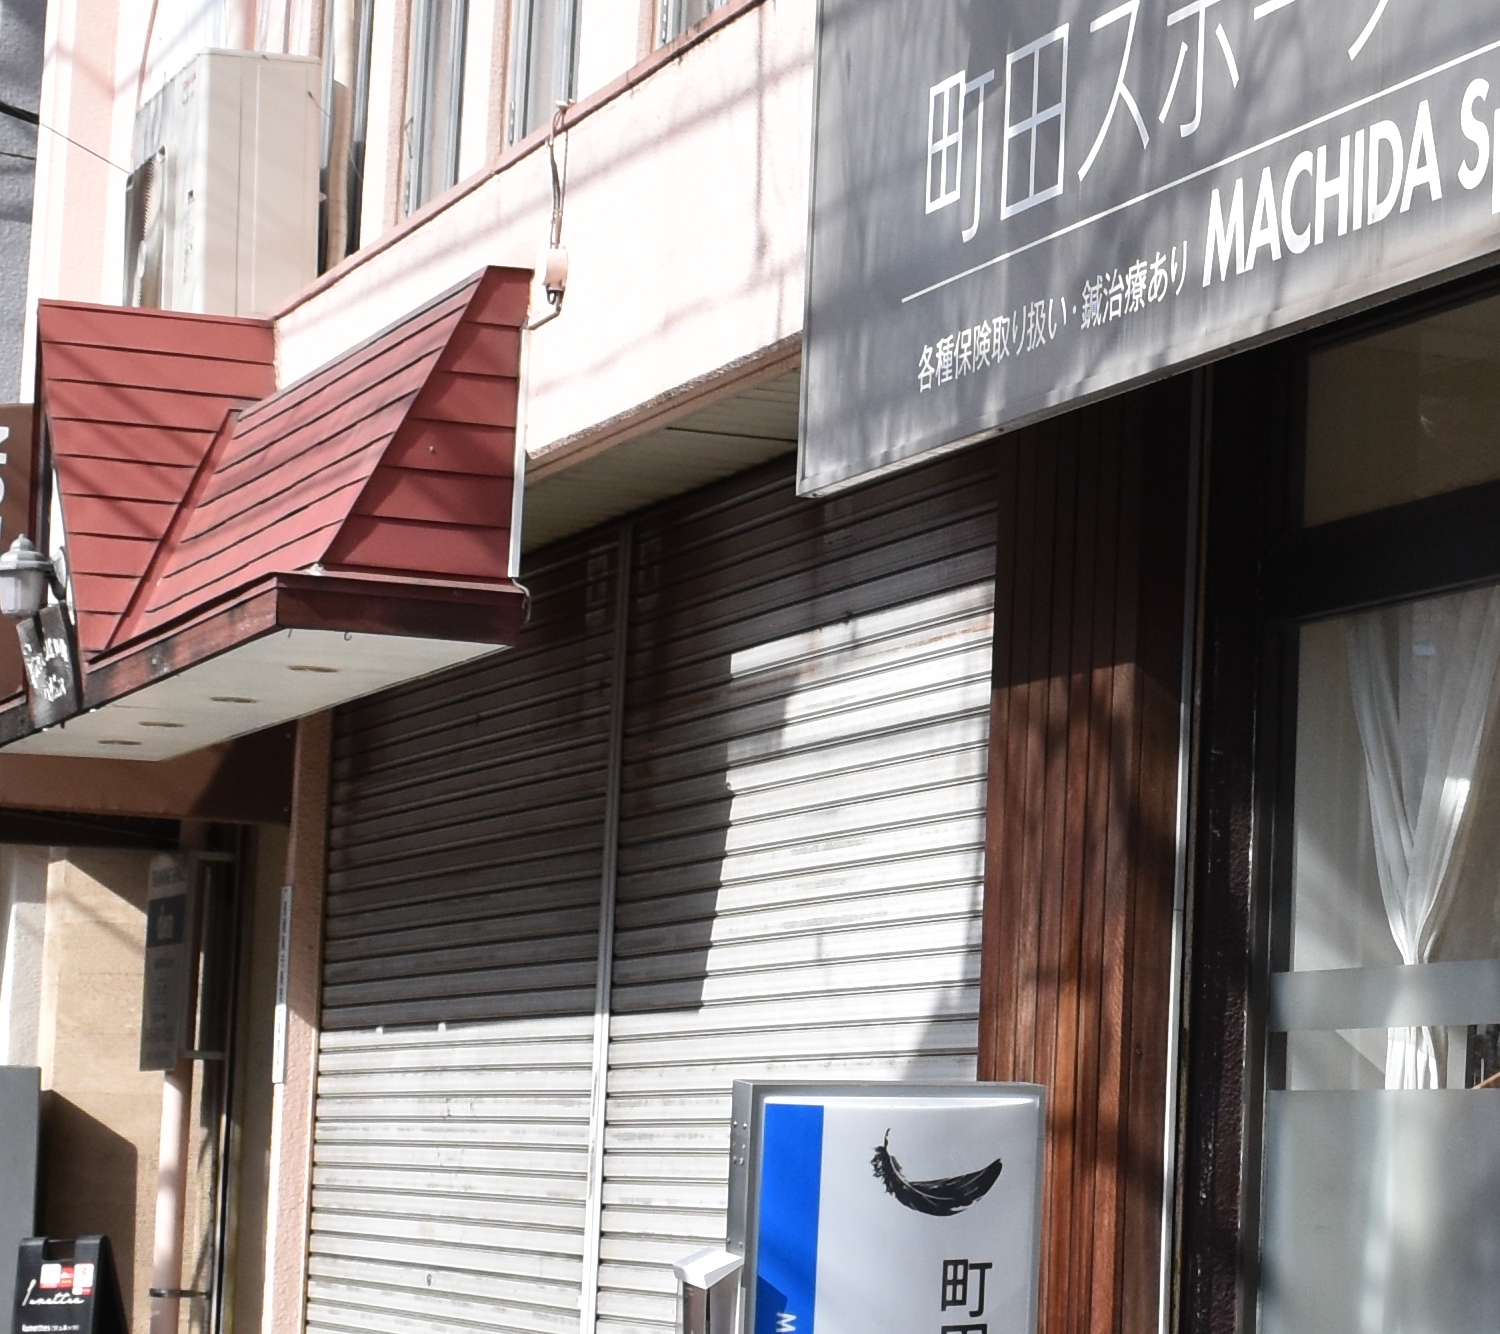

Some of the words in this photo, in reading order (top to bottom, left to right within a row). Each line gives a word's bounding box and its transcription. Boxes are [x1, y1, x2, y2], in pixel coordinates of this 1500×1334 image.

[1202, 99, 1444, 288] MACHIDA
[917, 240, 1188, 393] 各種保険取り扱い・鍼治療あり
